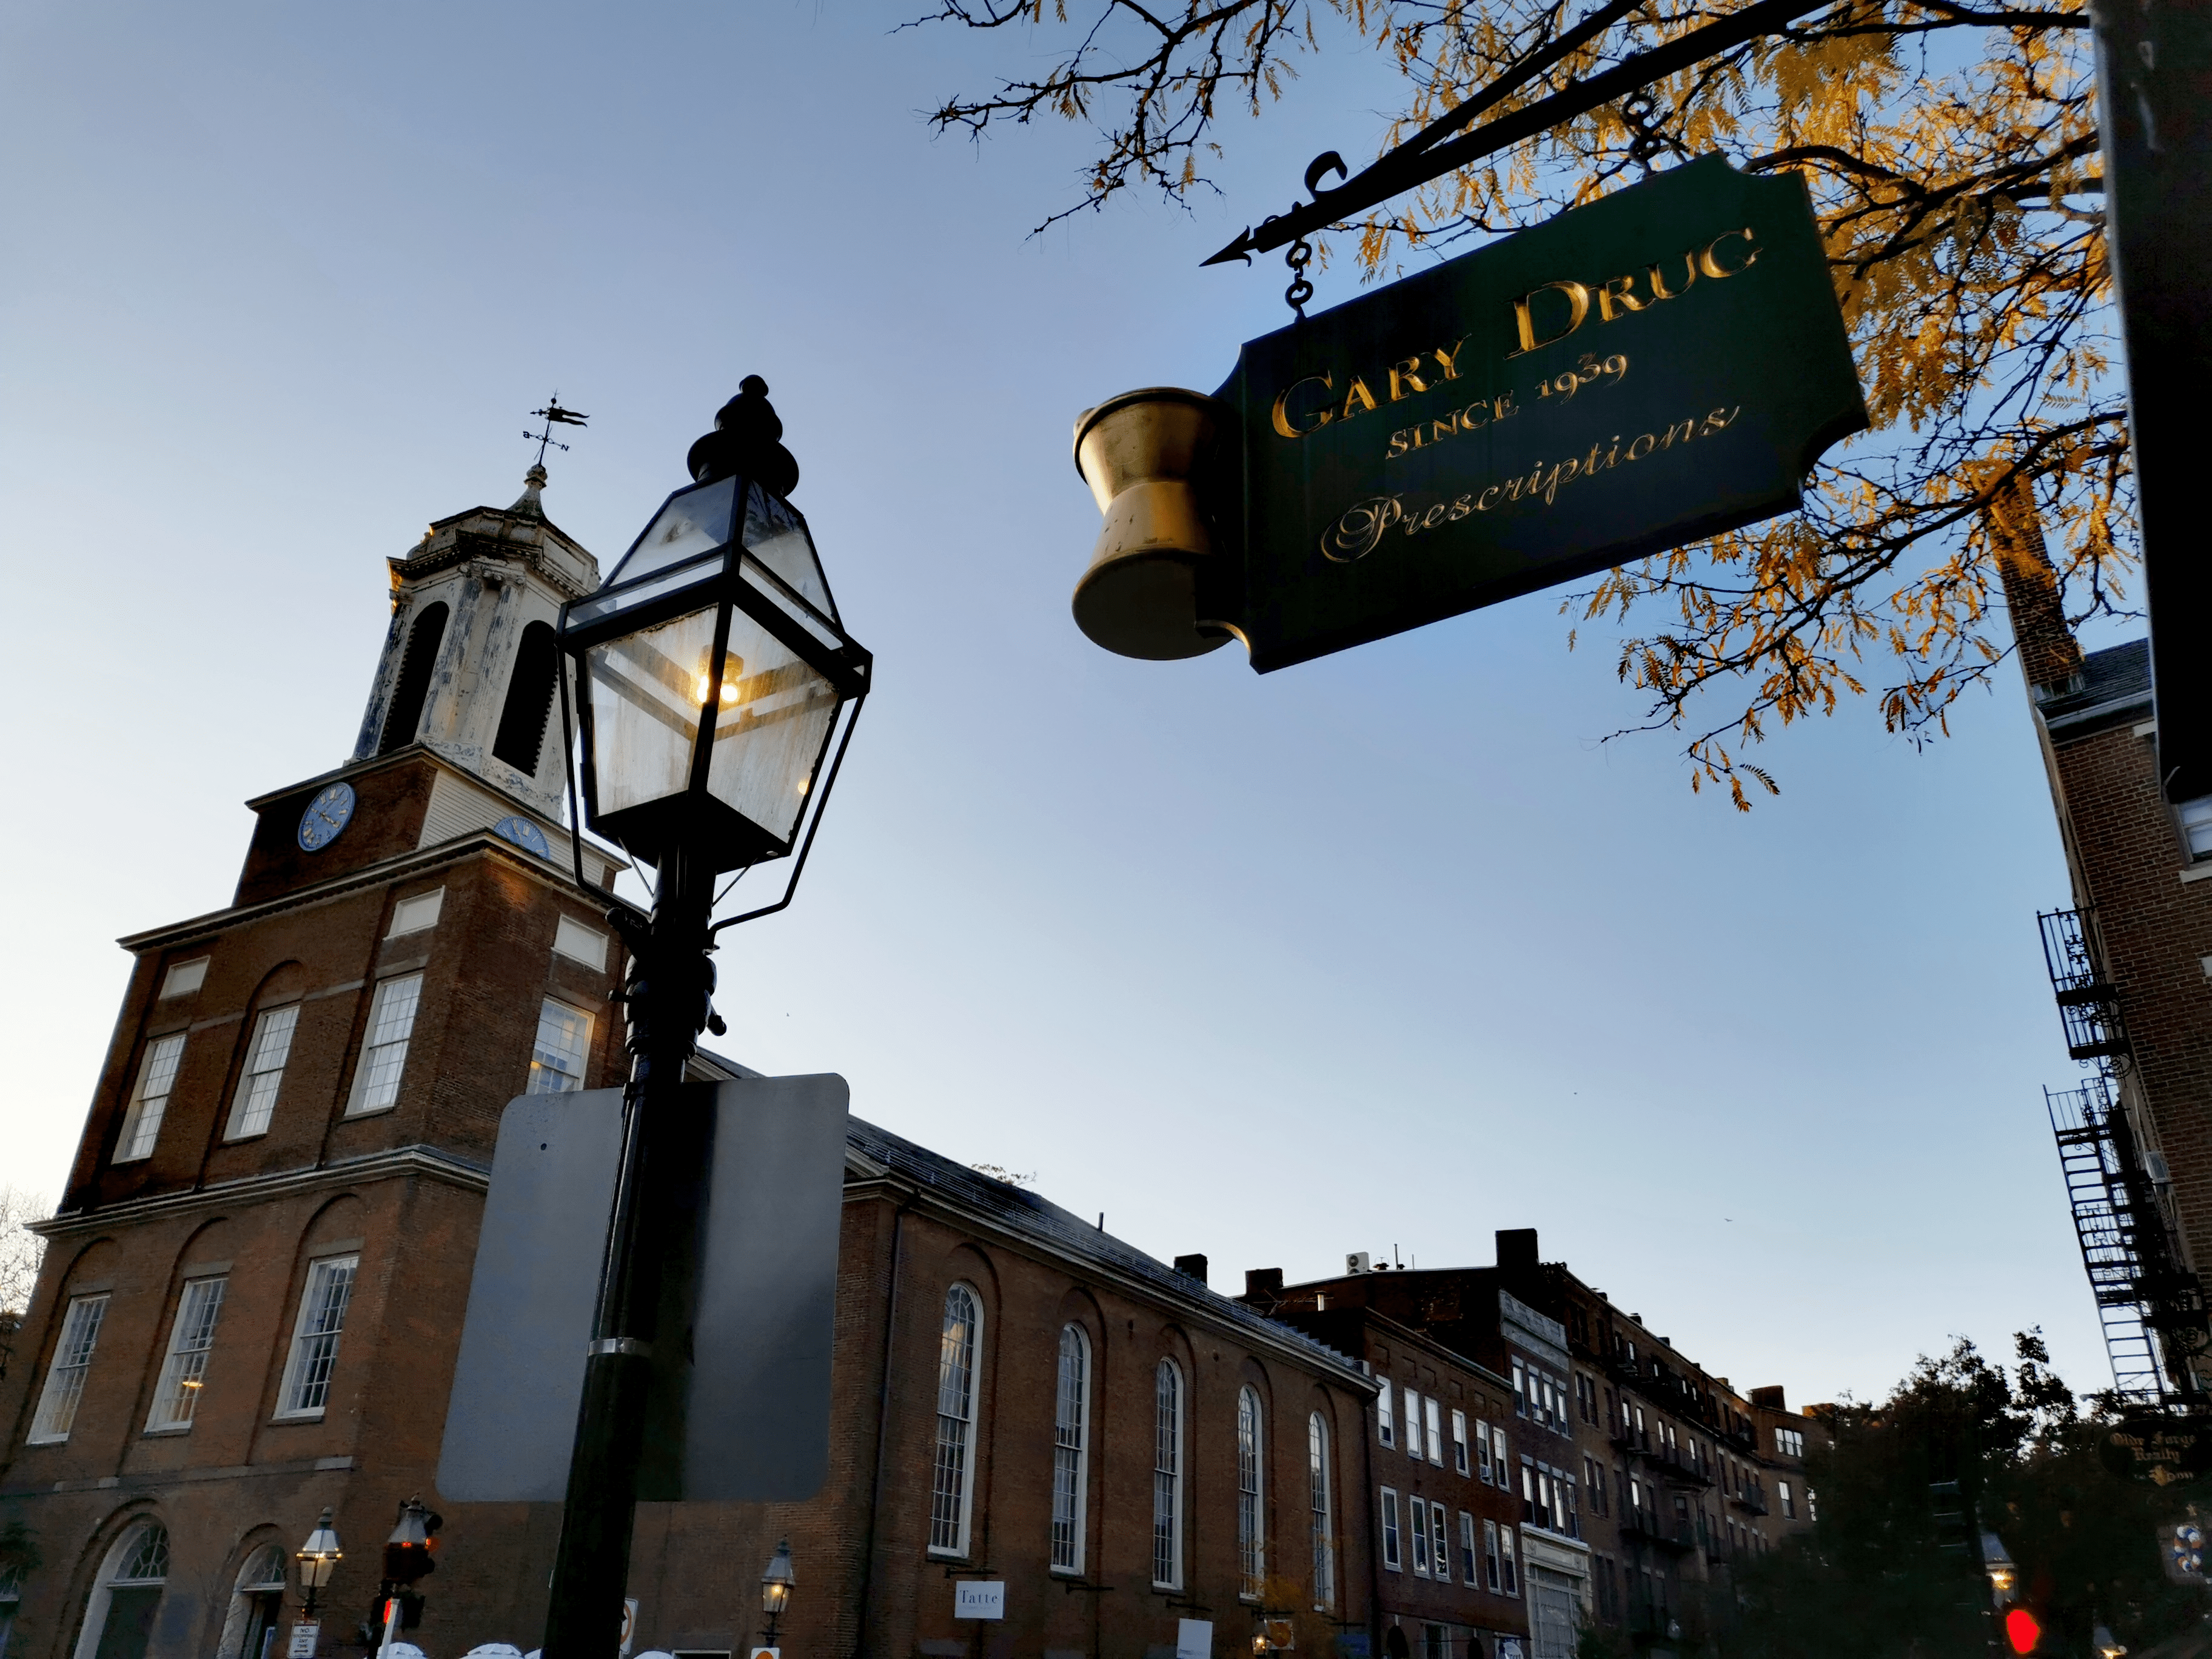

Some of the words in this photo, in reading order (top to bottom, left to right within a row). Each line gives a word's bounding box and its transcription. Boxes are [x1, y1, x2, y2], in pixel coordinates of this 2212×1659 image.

[1271, 332, 1472, 439] GARY
[1503, 227, 1764, 360] DRUG
[1384, 389, 1520, 461] SINCE
[1535, 352, 1629, 405] 1939
[1320, 405, 1740, 563] Prescriptions
[960, 1590, 999, 1604] Tatte
